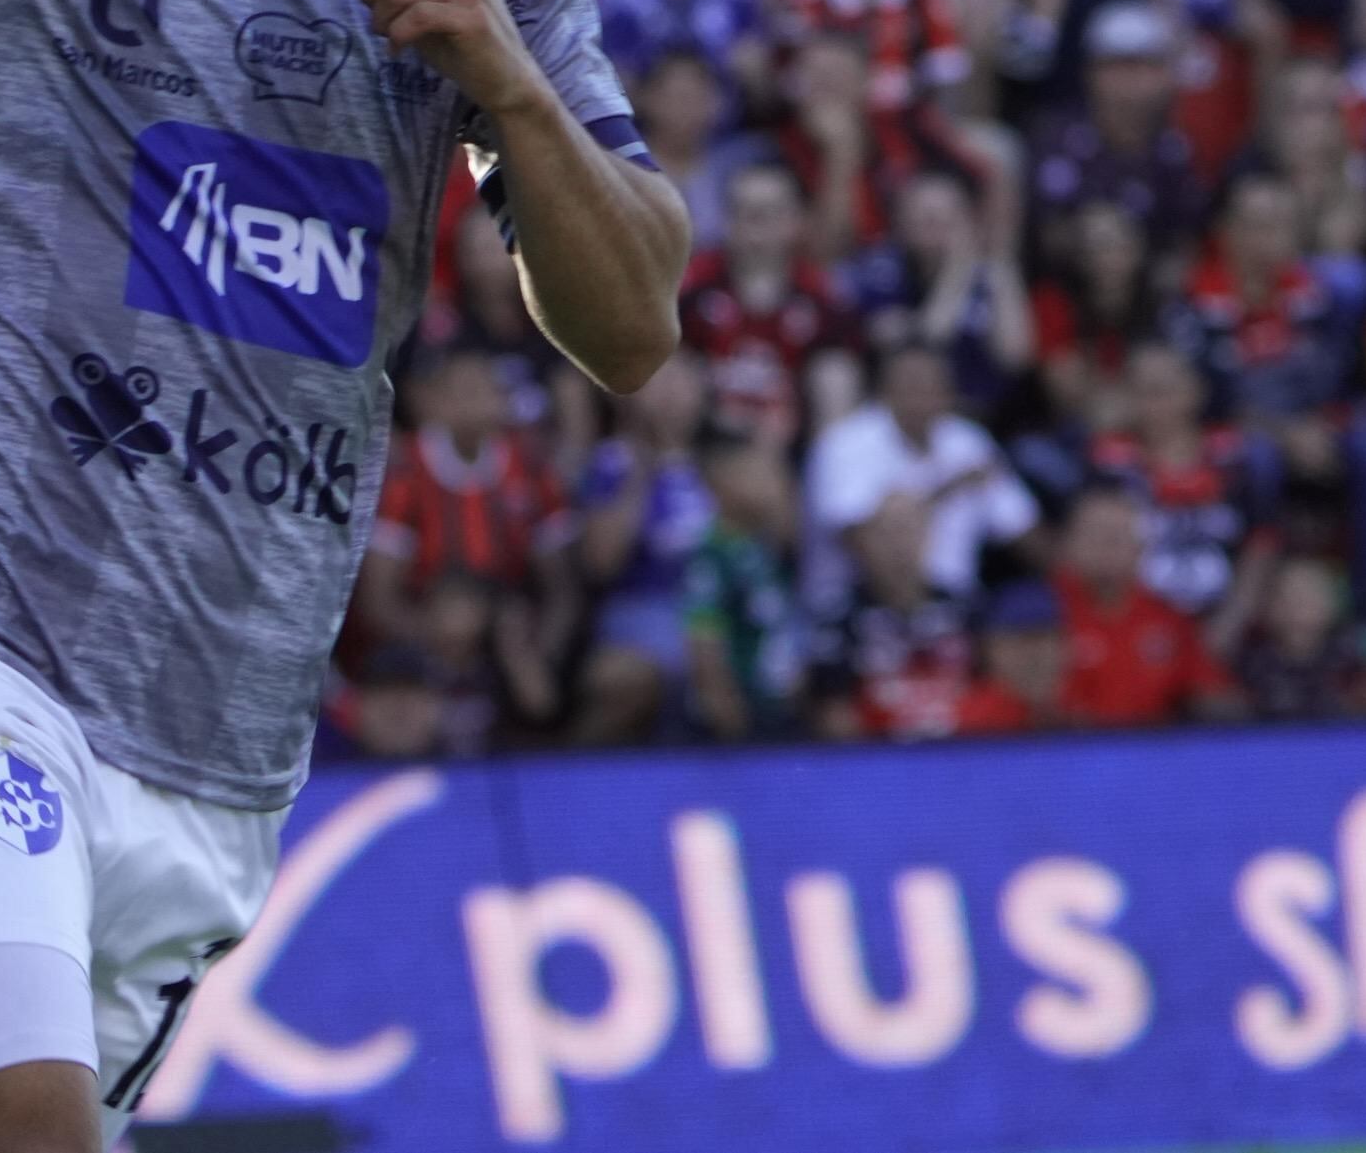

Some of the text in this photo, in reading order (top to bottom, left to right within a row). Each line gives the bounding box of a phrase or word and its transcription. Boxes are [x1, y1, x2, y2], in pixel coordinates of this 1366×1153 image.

[102, 54, 201, 98] Marcos
[233, 200, 368, 302] BN
[461, 809, 1153, 1145] plus
